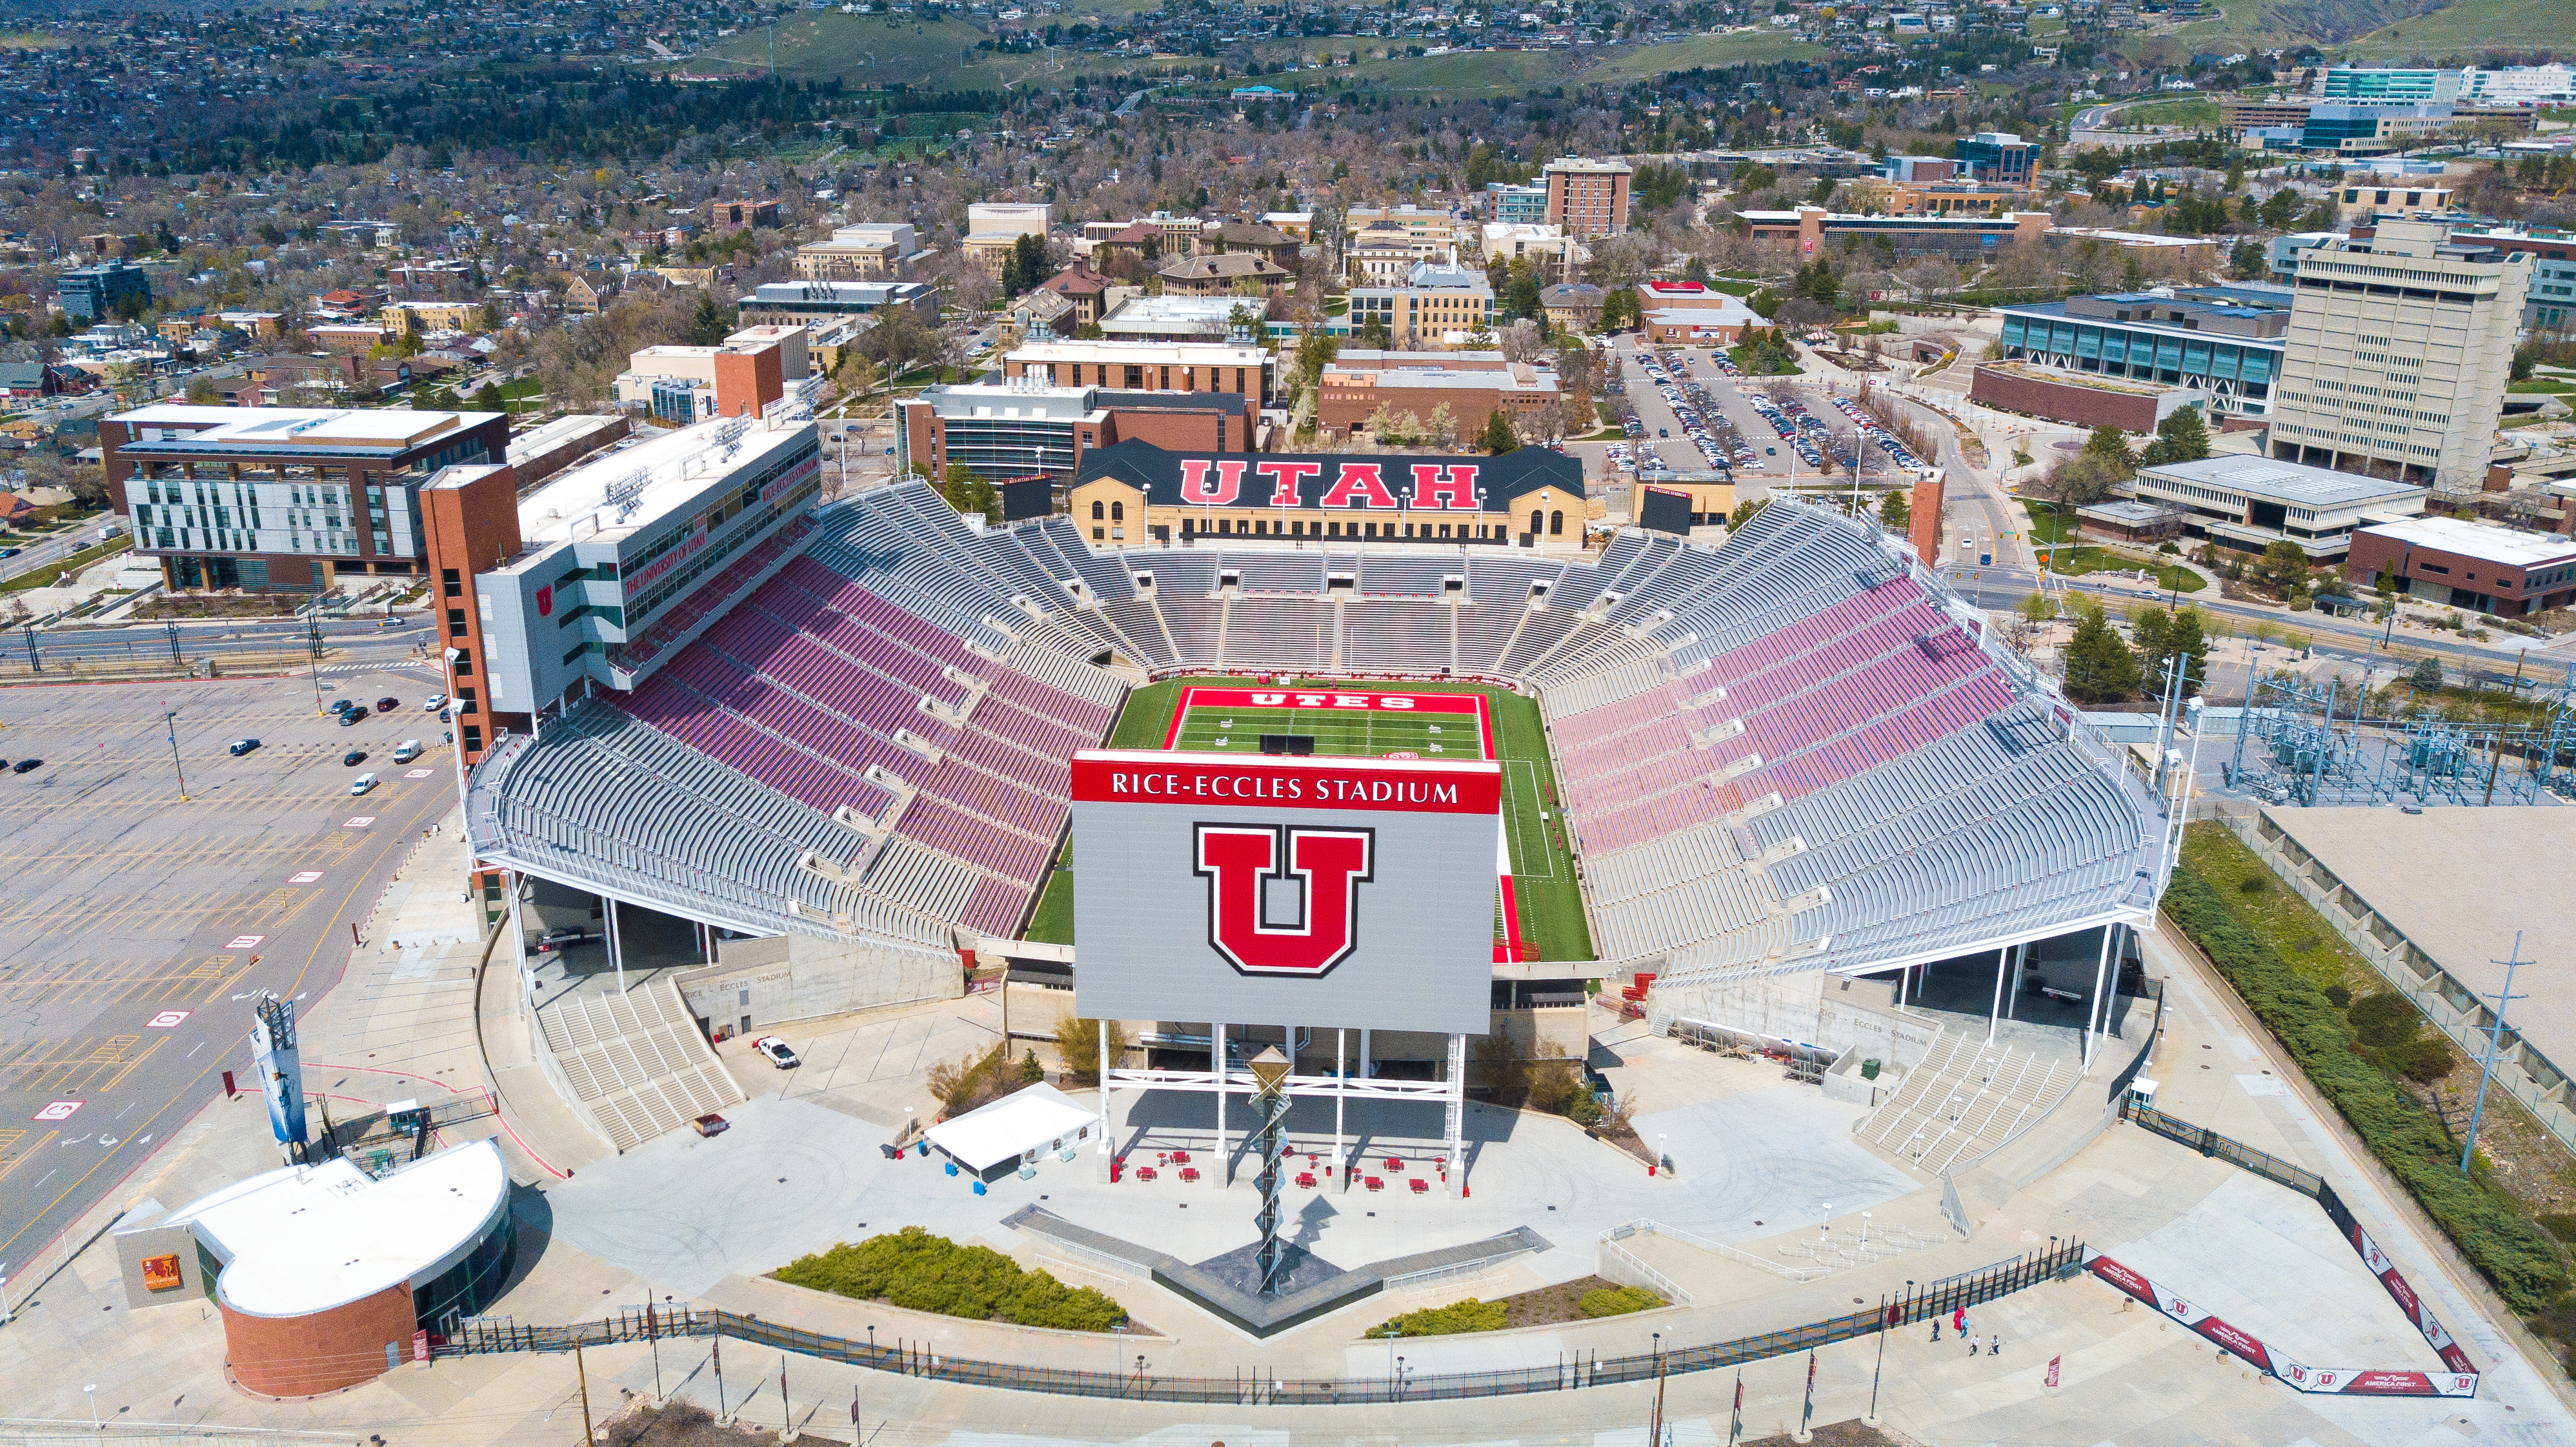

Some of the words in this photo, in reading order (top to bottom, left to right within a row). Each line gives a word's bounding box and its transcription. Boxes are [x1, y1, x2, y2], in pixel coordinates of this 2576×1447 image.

[763, 471, 795, 503] RICE-ECCLES
[796, 456, 817, 480] STADIUM
[1180, 459, 1480, 510] UTAH
[626, 576, 640, 595] THE
[641, 553, 678, 585] UNIVERSITY
[678, 545, 687, 560] OF
[689, 531, 705, 553] UTAH
[536, 584, 552, 617] U
[1251, 694, 1414, 709] UTES
[1112, 773, 1302, 799] RICE-ECCLES
[1315, 778, 1458, 805] STADIUM
[1192, 821, 1376, 979] U
[719, 980, 749, 992] ECCLES
[756, 970, 792, 984] STADIUM
[1820, 1008, 1837, 1020] RICE
[1853, 1018, 1883, 1033] ECCLES
[1890, 1029, 1927, 1047] STADIUM
[2102, 1265, 2126, 1283] AMERICA
[2125, 1278, 2142, 1291] FIRST
[2175, 1300, 2186, 1314] U
[2211, 1327, 2237, 1346] AMERICA
[2236, 1340, 2256, 1355] FIRST
[2293, 1368, 2304, 1380] U
[2320, 1373, 2333, 1384] U
[2458, 1377, 2470, 1388] U
